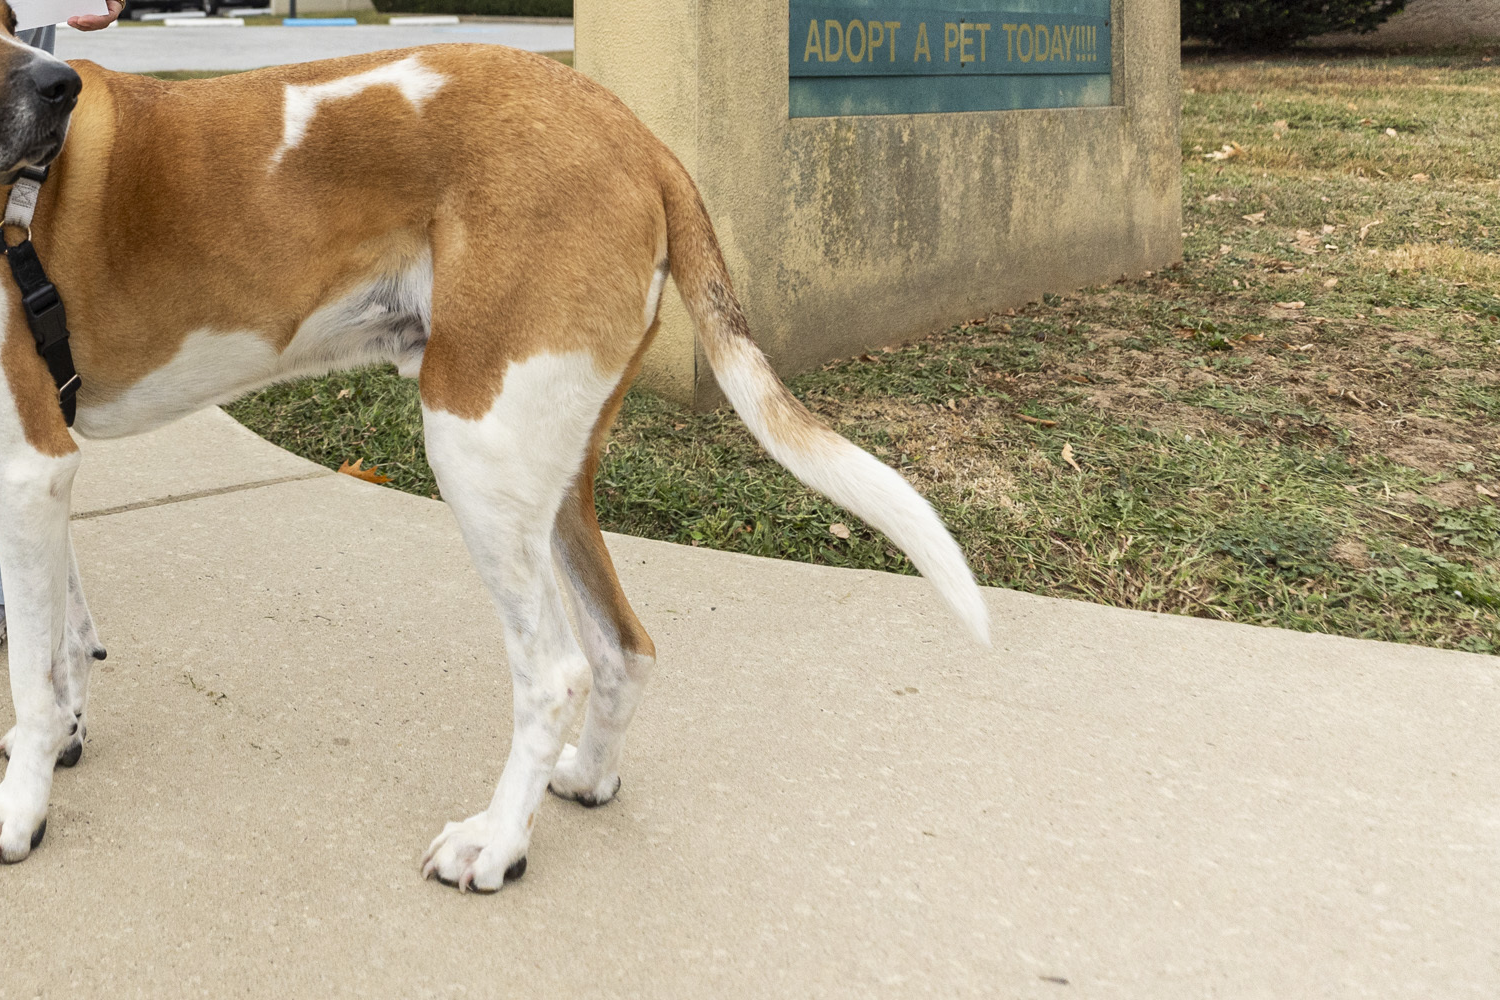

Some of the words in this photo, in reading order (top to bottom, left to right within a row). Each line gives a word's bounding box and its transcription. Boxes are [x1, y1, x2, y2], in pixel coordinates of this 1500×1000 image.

[803, 19, 901, 63] ADOPT
[914, 22, 931, 63] A
[944, 23, 991, 63] PET
[1002, 23, 1097, 63] TODAY!!!!
